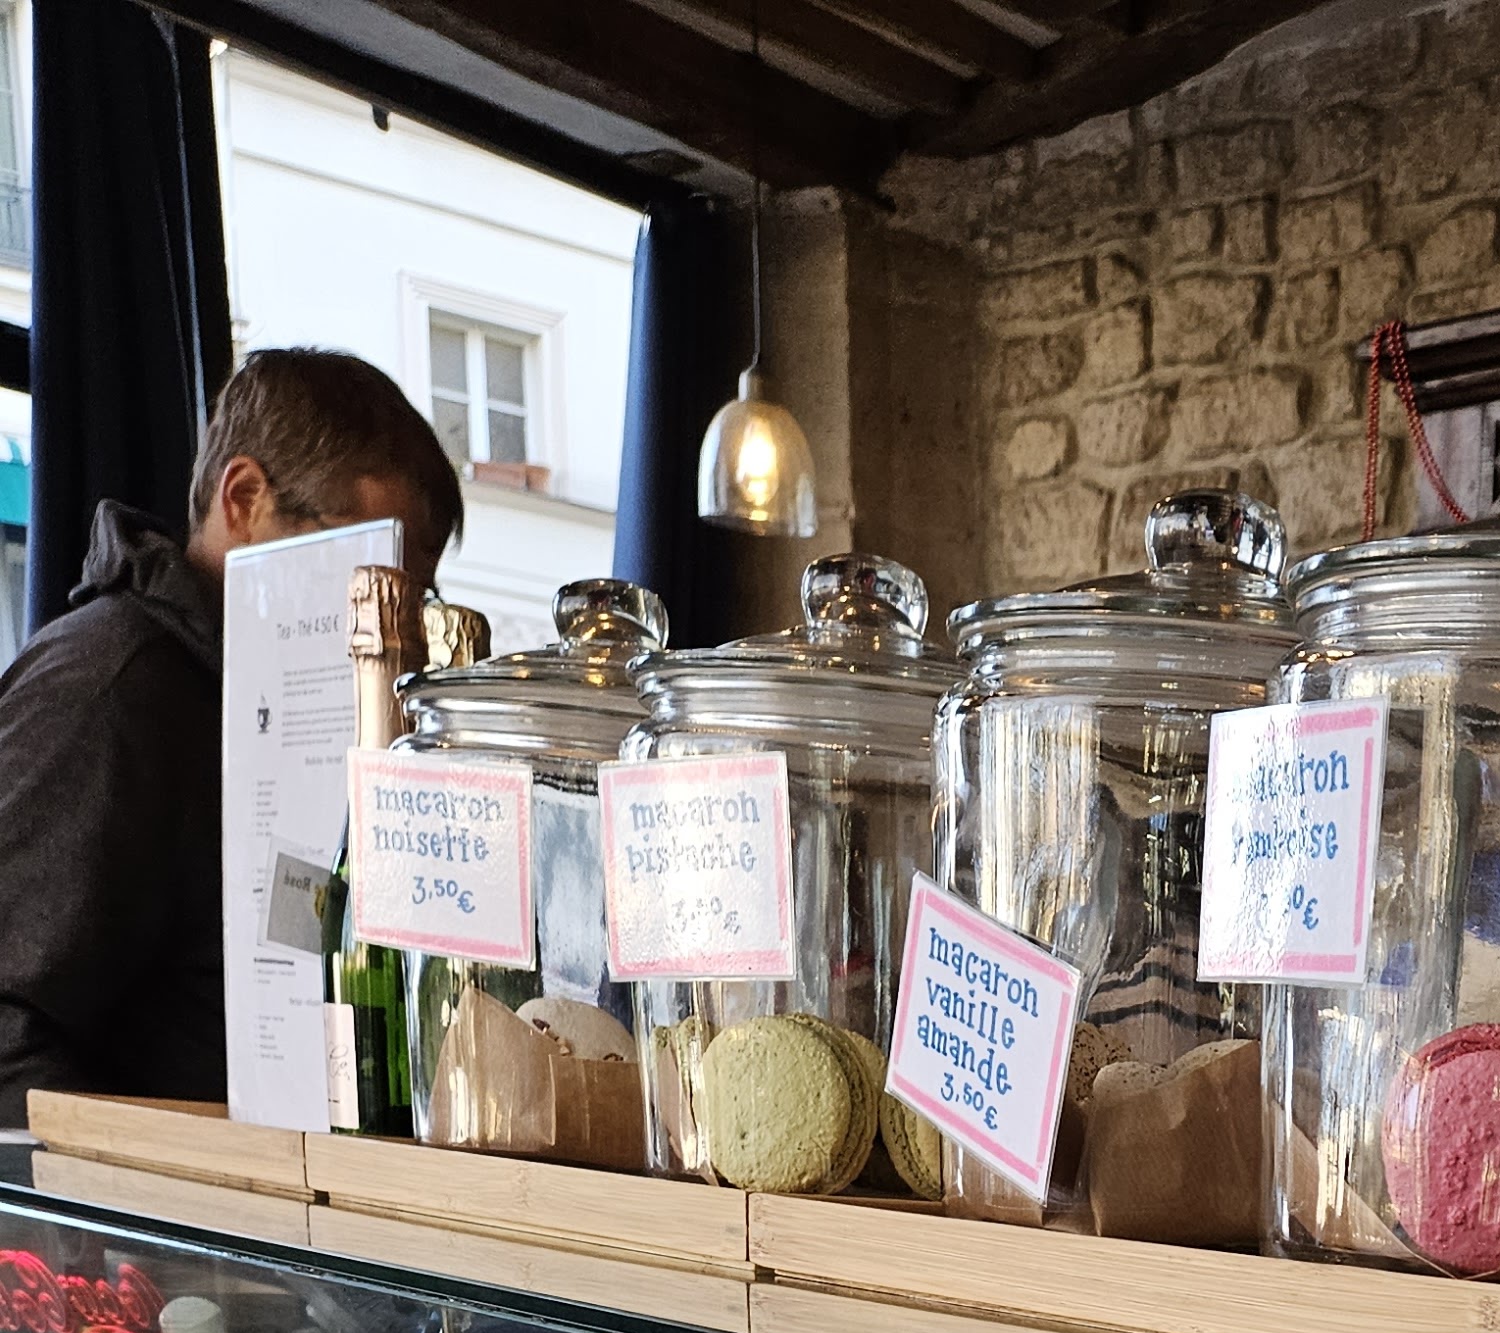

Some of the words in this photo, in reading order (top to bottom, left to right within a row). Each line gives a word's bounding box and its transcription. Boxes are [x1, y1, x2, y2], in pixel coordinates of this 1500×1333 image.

[374, 785, 504, 823] macaron
[373, 821, 490, 863] noisette
[928, 927, 1039, 1018] macaron
[925, 977, 1015, 1050] vanille
[917, 1014, 1013, 1096] amande
